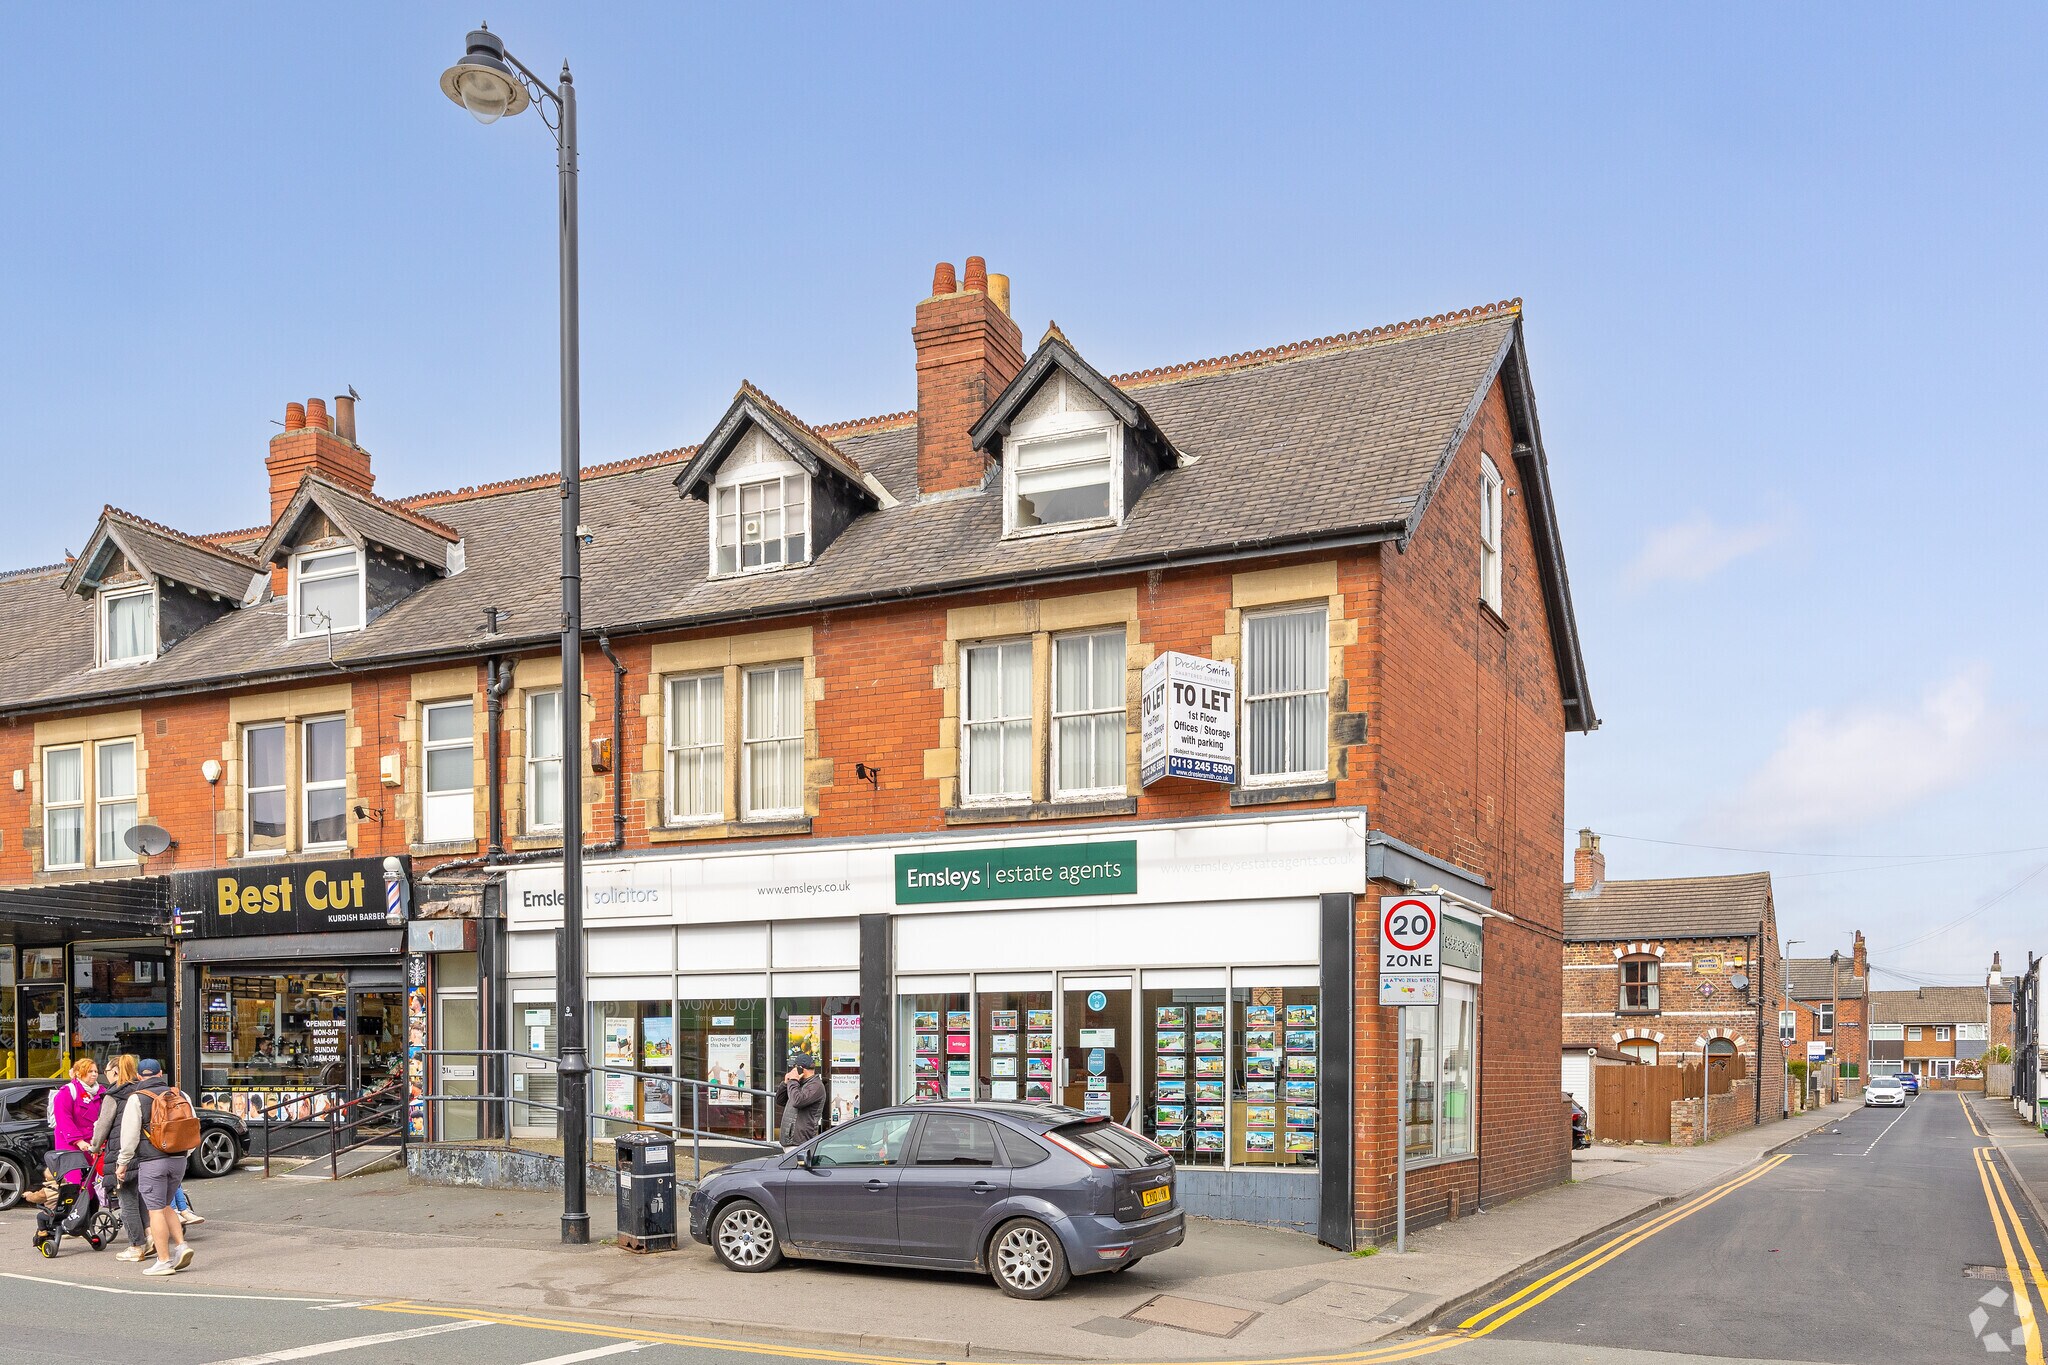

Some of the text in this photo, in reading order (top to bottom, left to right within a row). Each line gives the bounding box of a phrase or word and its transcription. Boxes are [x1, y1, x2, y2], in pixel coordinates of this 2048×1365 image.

[1143, 684, 1165, 717] TO LET
[1173, 682, 1231, 713] TO LET
[1188, 710, 1217, 723] 1st Floor
[1173, 720, 1199, 733] Offices
[1204, 725, 1231, 740] Storage
[1181, 735, 1224, 751] with parking
[1170, 757, 1193, 769] 0113
[1194, 760, 1211, 772] 245
[1212, 763, 1233, 775] 5599
[907, 861, 1122, 892] Emsleys estate agents
[217, 870, 365, 916] Best Cut
[757, 880, 851, 896] www.emsleys.co.uk
[523, 886, 659, 907] Emsle solicitors
[327, 914, 358, 923] KURDISH
[1393, 915, 1429, 936] 20
[1386, 954, 1433, 967] ZONE
[305, 1019, 332, 1028] OPENING
[833, 1017, 849, 1026] 20%
[313, 1028, 339, 1036] MON-SAT
[314, 1046, 338, 1054] SUNDAY
